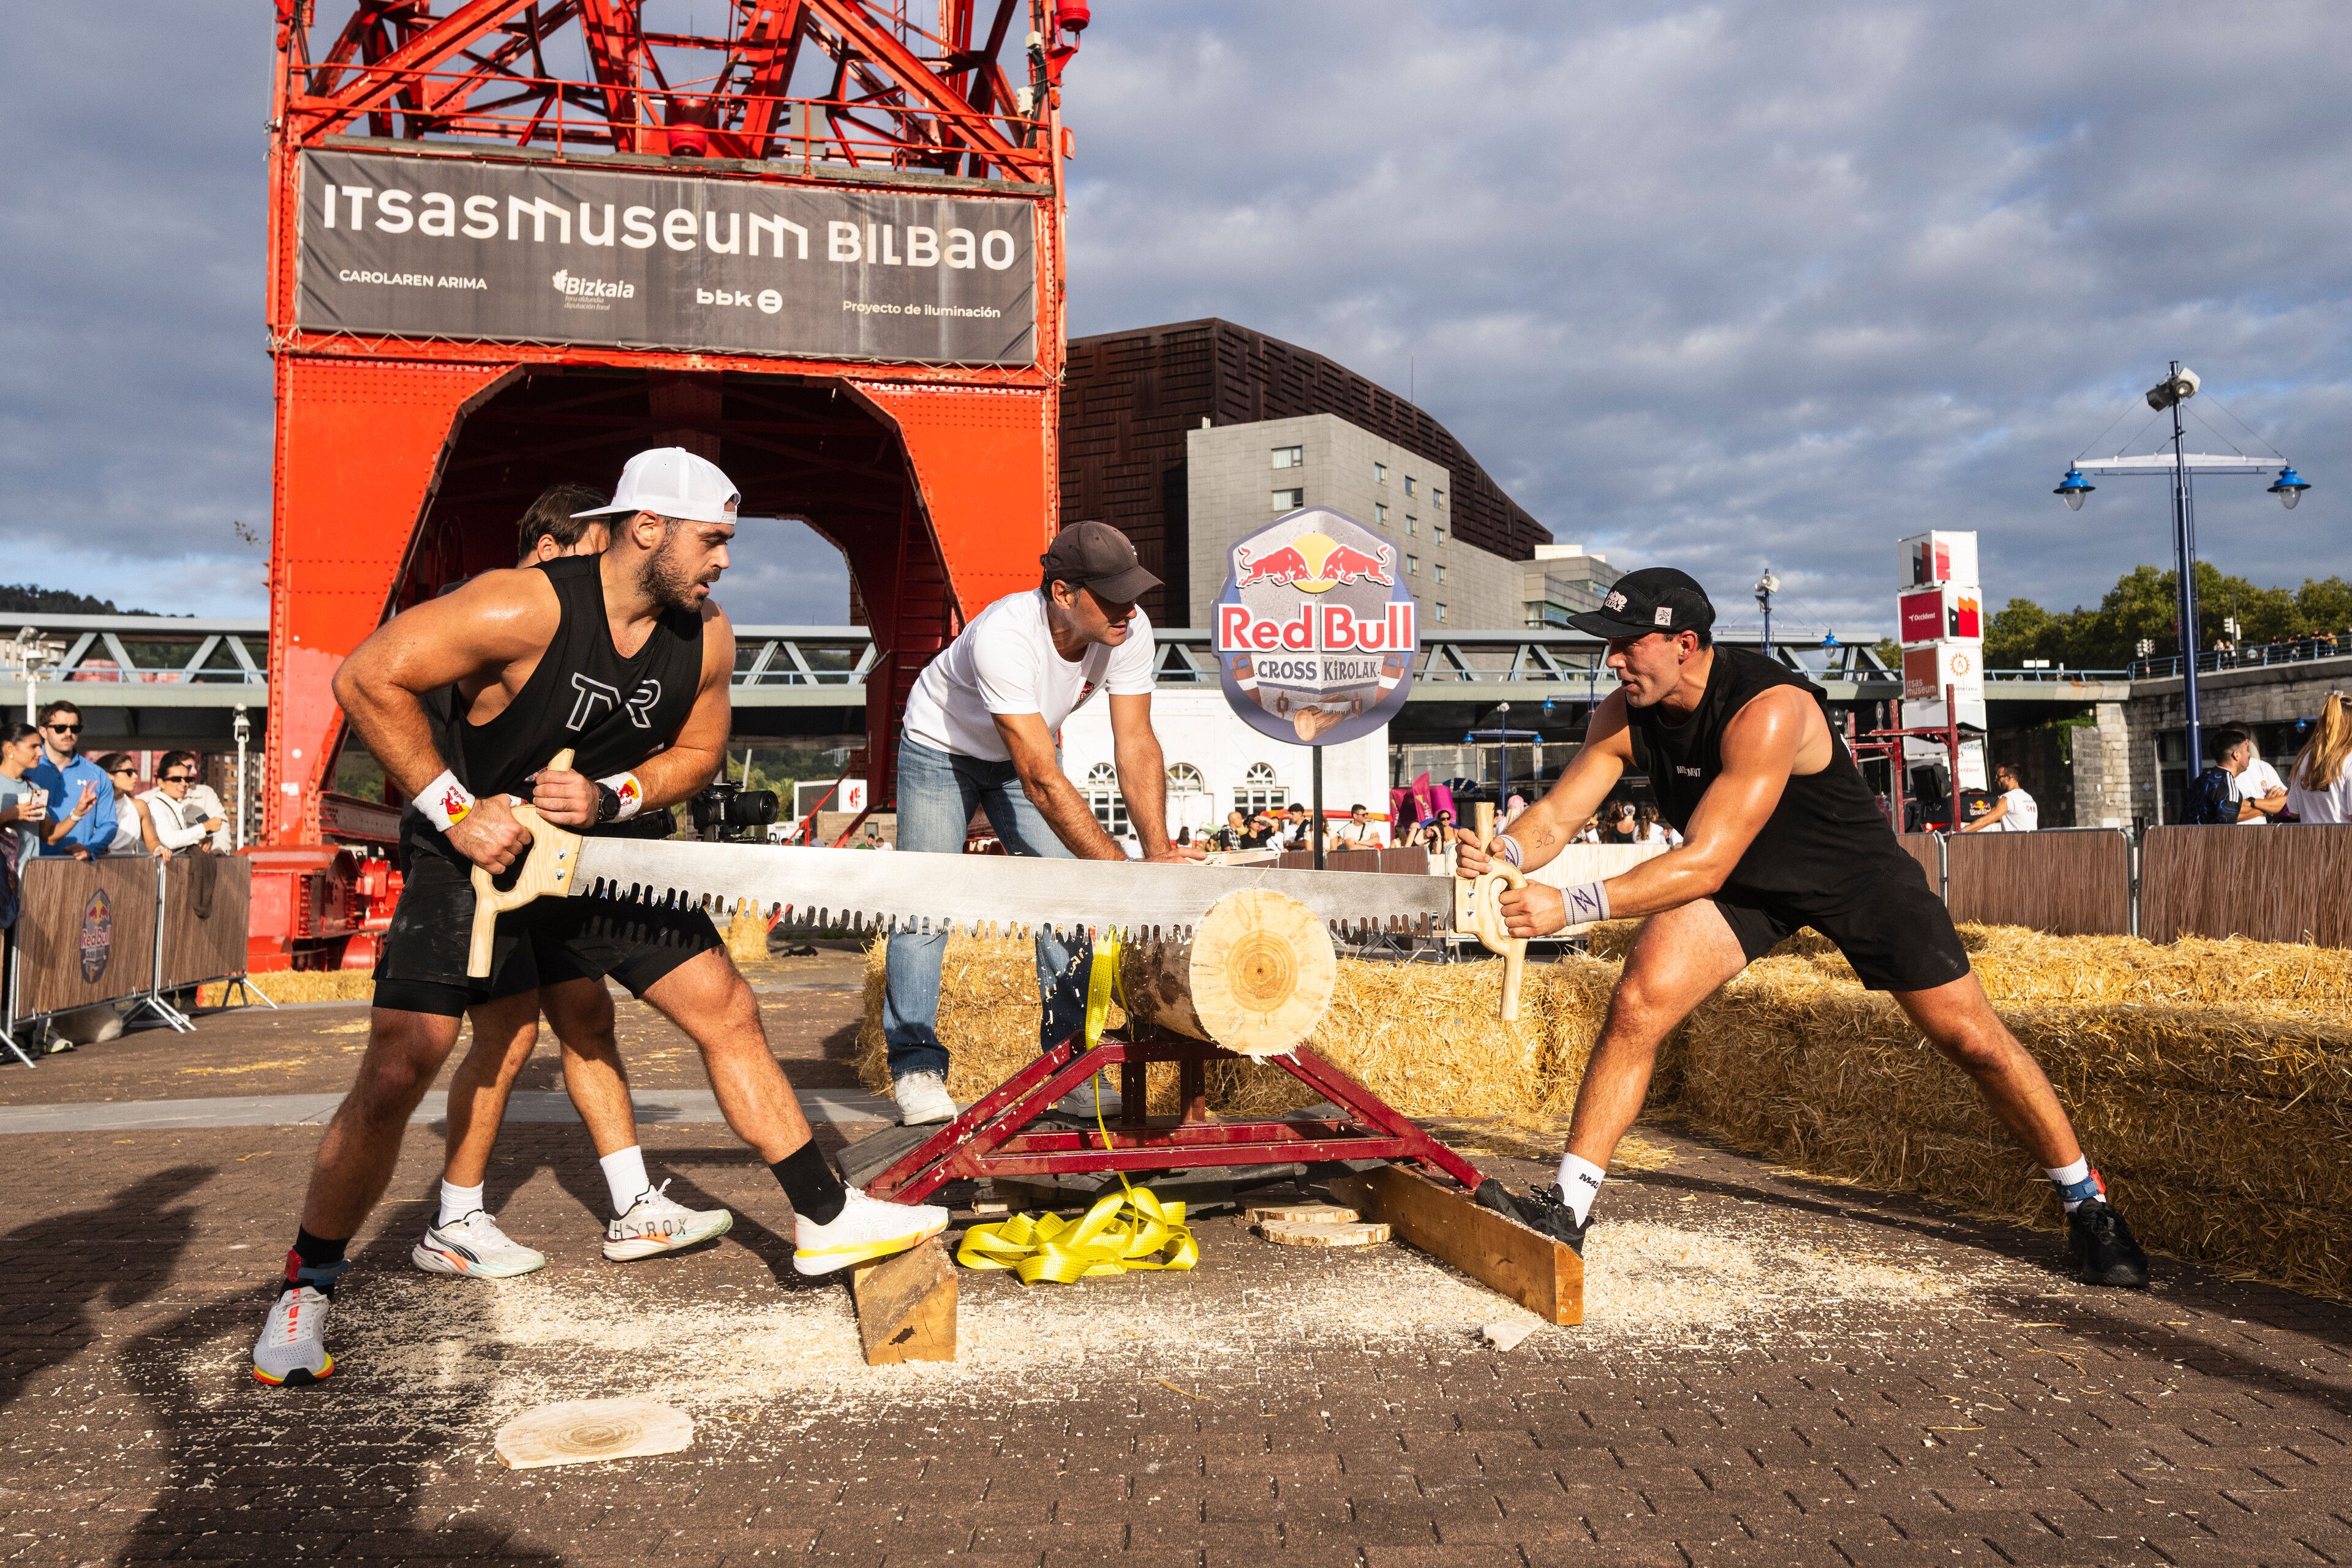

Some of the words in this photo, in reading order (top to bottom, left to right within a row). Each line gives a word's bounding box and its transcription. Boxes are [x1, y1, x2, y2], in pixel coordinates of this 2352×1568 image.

[339, 270, 434, 287] CAROLAREN
[437, 276, 488, 290] ARIMA
[565, 277, 635, 292] Bizkaia
[696, 288, 752, 307] bbk
[843, 301, 901, 314] Proyecto
[904, 304, 921, 315] de
[924, 304, 1001, 318] iluminación
[1914, 612, 1936, 621] Occident
[1221, 605, 1313, 649] Red
[1324, 605, 1412, 649] Bull
[1257, 660, 1318, 680] CROSS
[1907, 685, 1937, 696] museum
[81, 929, 96, 948] Red
[97, 925, 111, 946] Bull
[614, 1218, 687, 1238] HYROX
[843, 1217, 892, 1241] TYR
